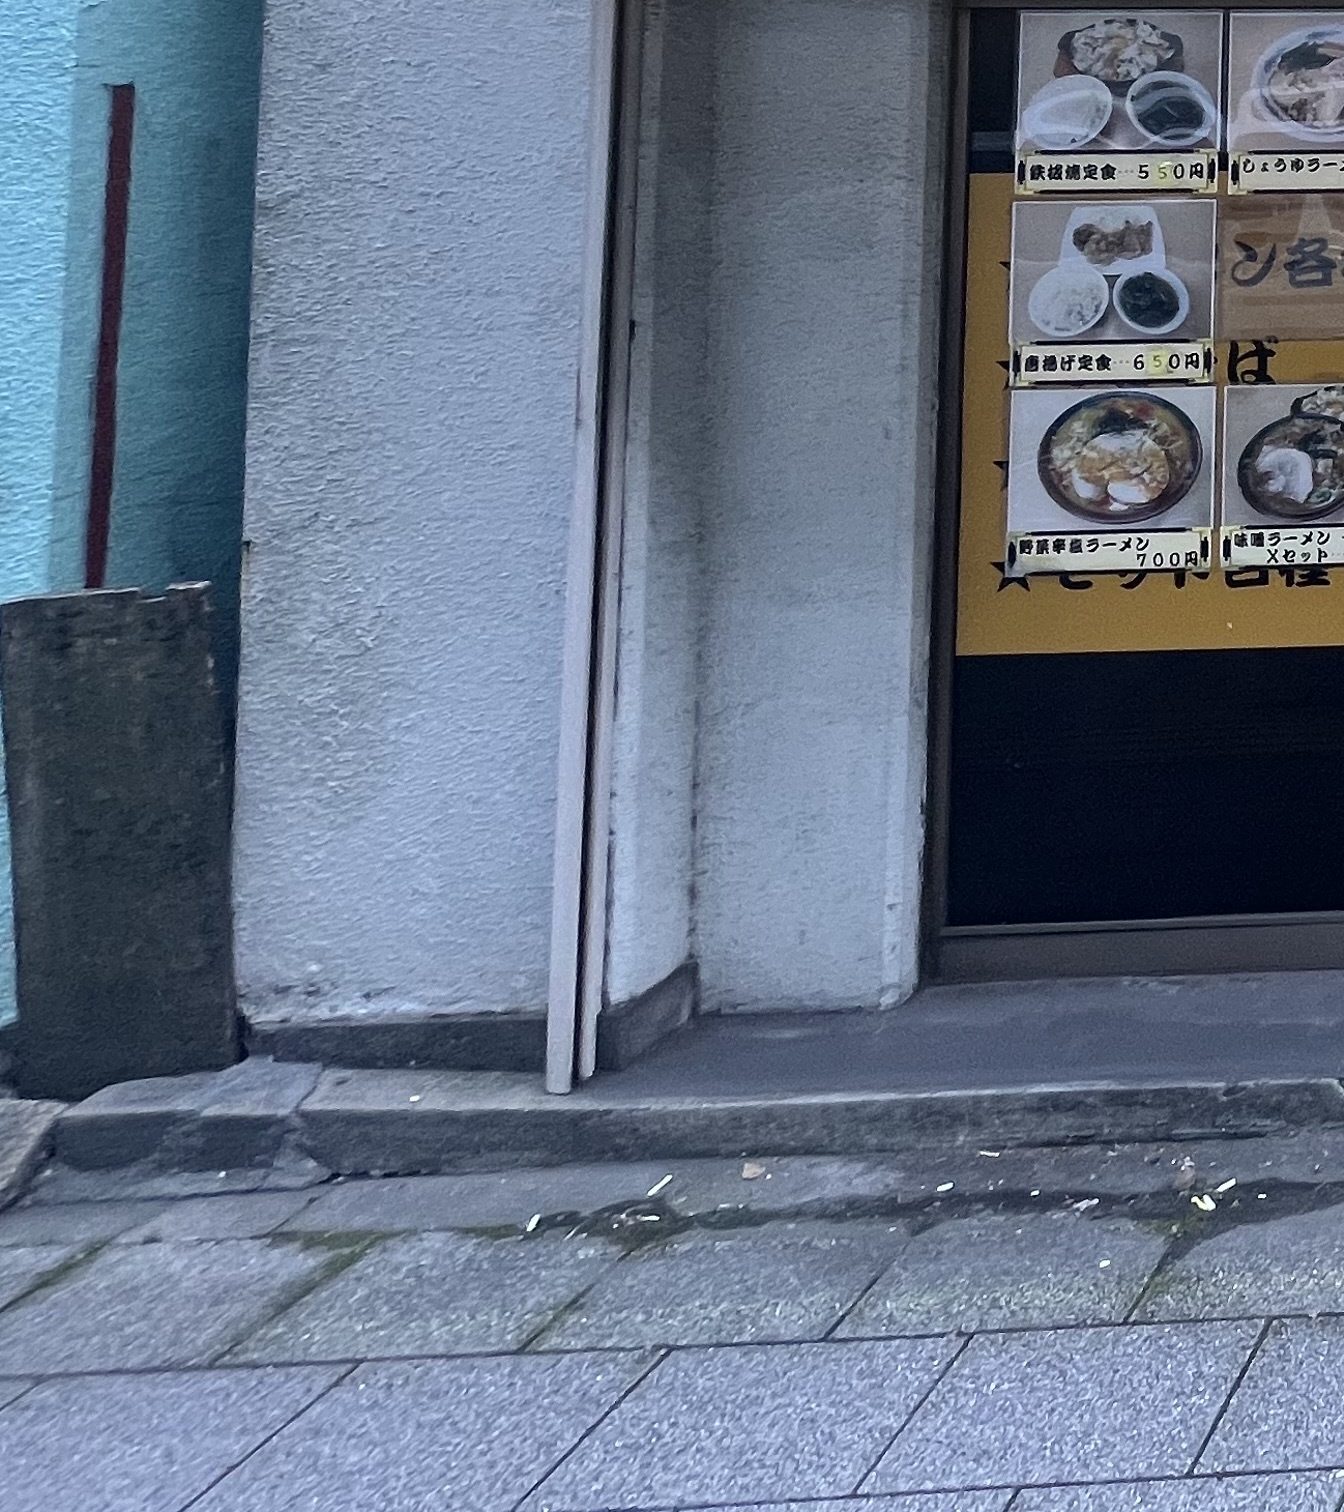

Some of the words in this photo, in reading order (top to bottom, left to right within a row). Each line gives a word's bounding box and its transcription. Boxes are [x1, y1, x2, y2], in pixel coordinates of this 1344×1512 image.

[1234, 531, 1330, 548] 味噌ラーメン
[1136, 551, 1198, 567] 700円
